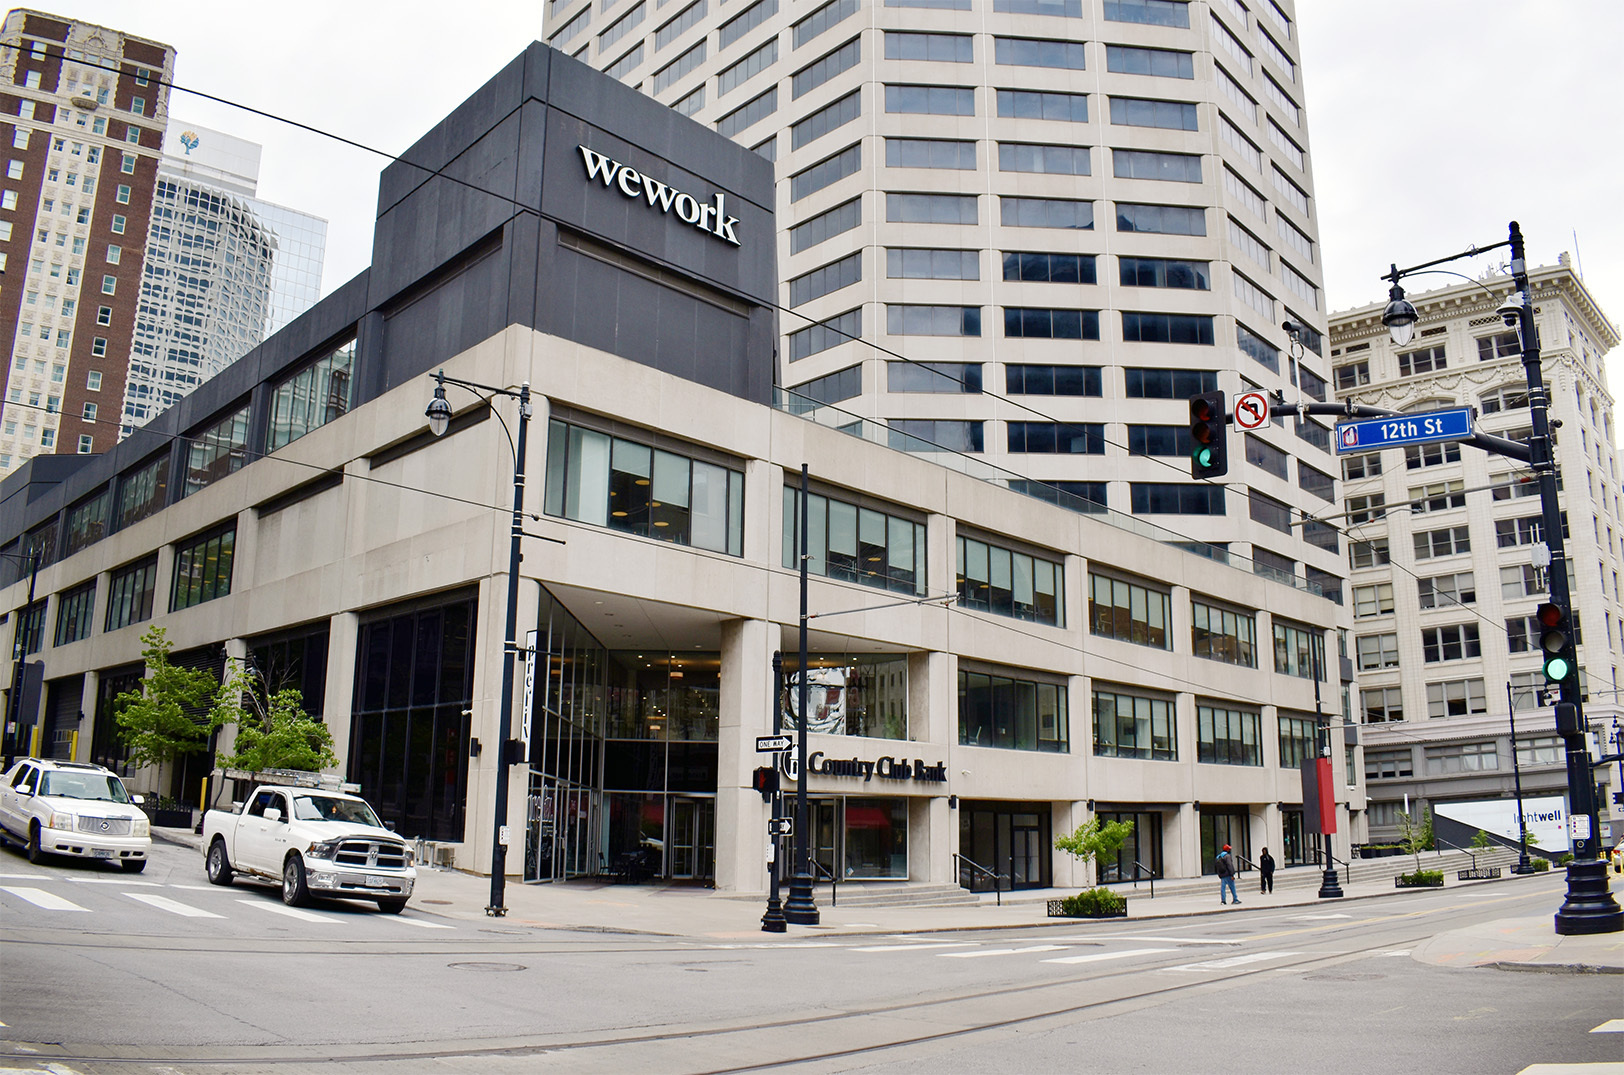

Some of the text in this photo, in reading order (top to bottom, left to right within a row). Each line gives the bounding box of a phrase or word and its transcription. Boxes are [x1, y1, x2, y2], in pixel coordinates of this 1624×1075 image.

[577, 144, 742, 247] wework
[1381, 418, 1443, 440] 12th St
[759, 739, 785, 749] ONE WAY
[808, 751, 948, 782] Country Club Bank
